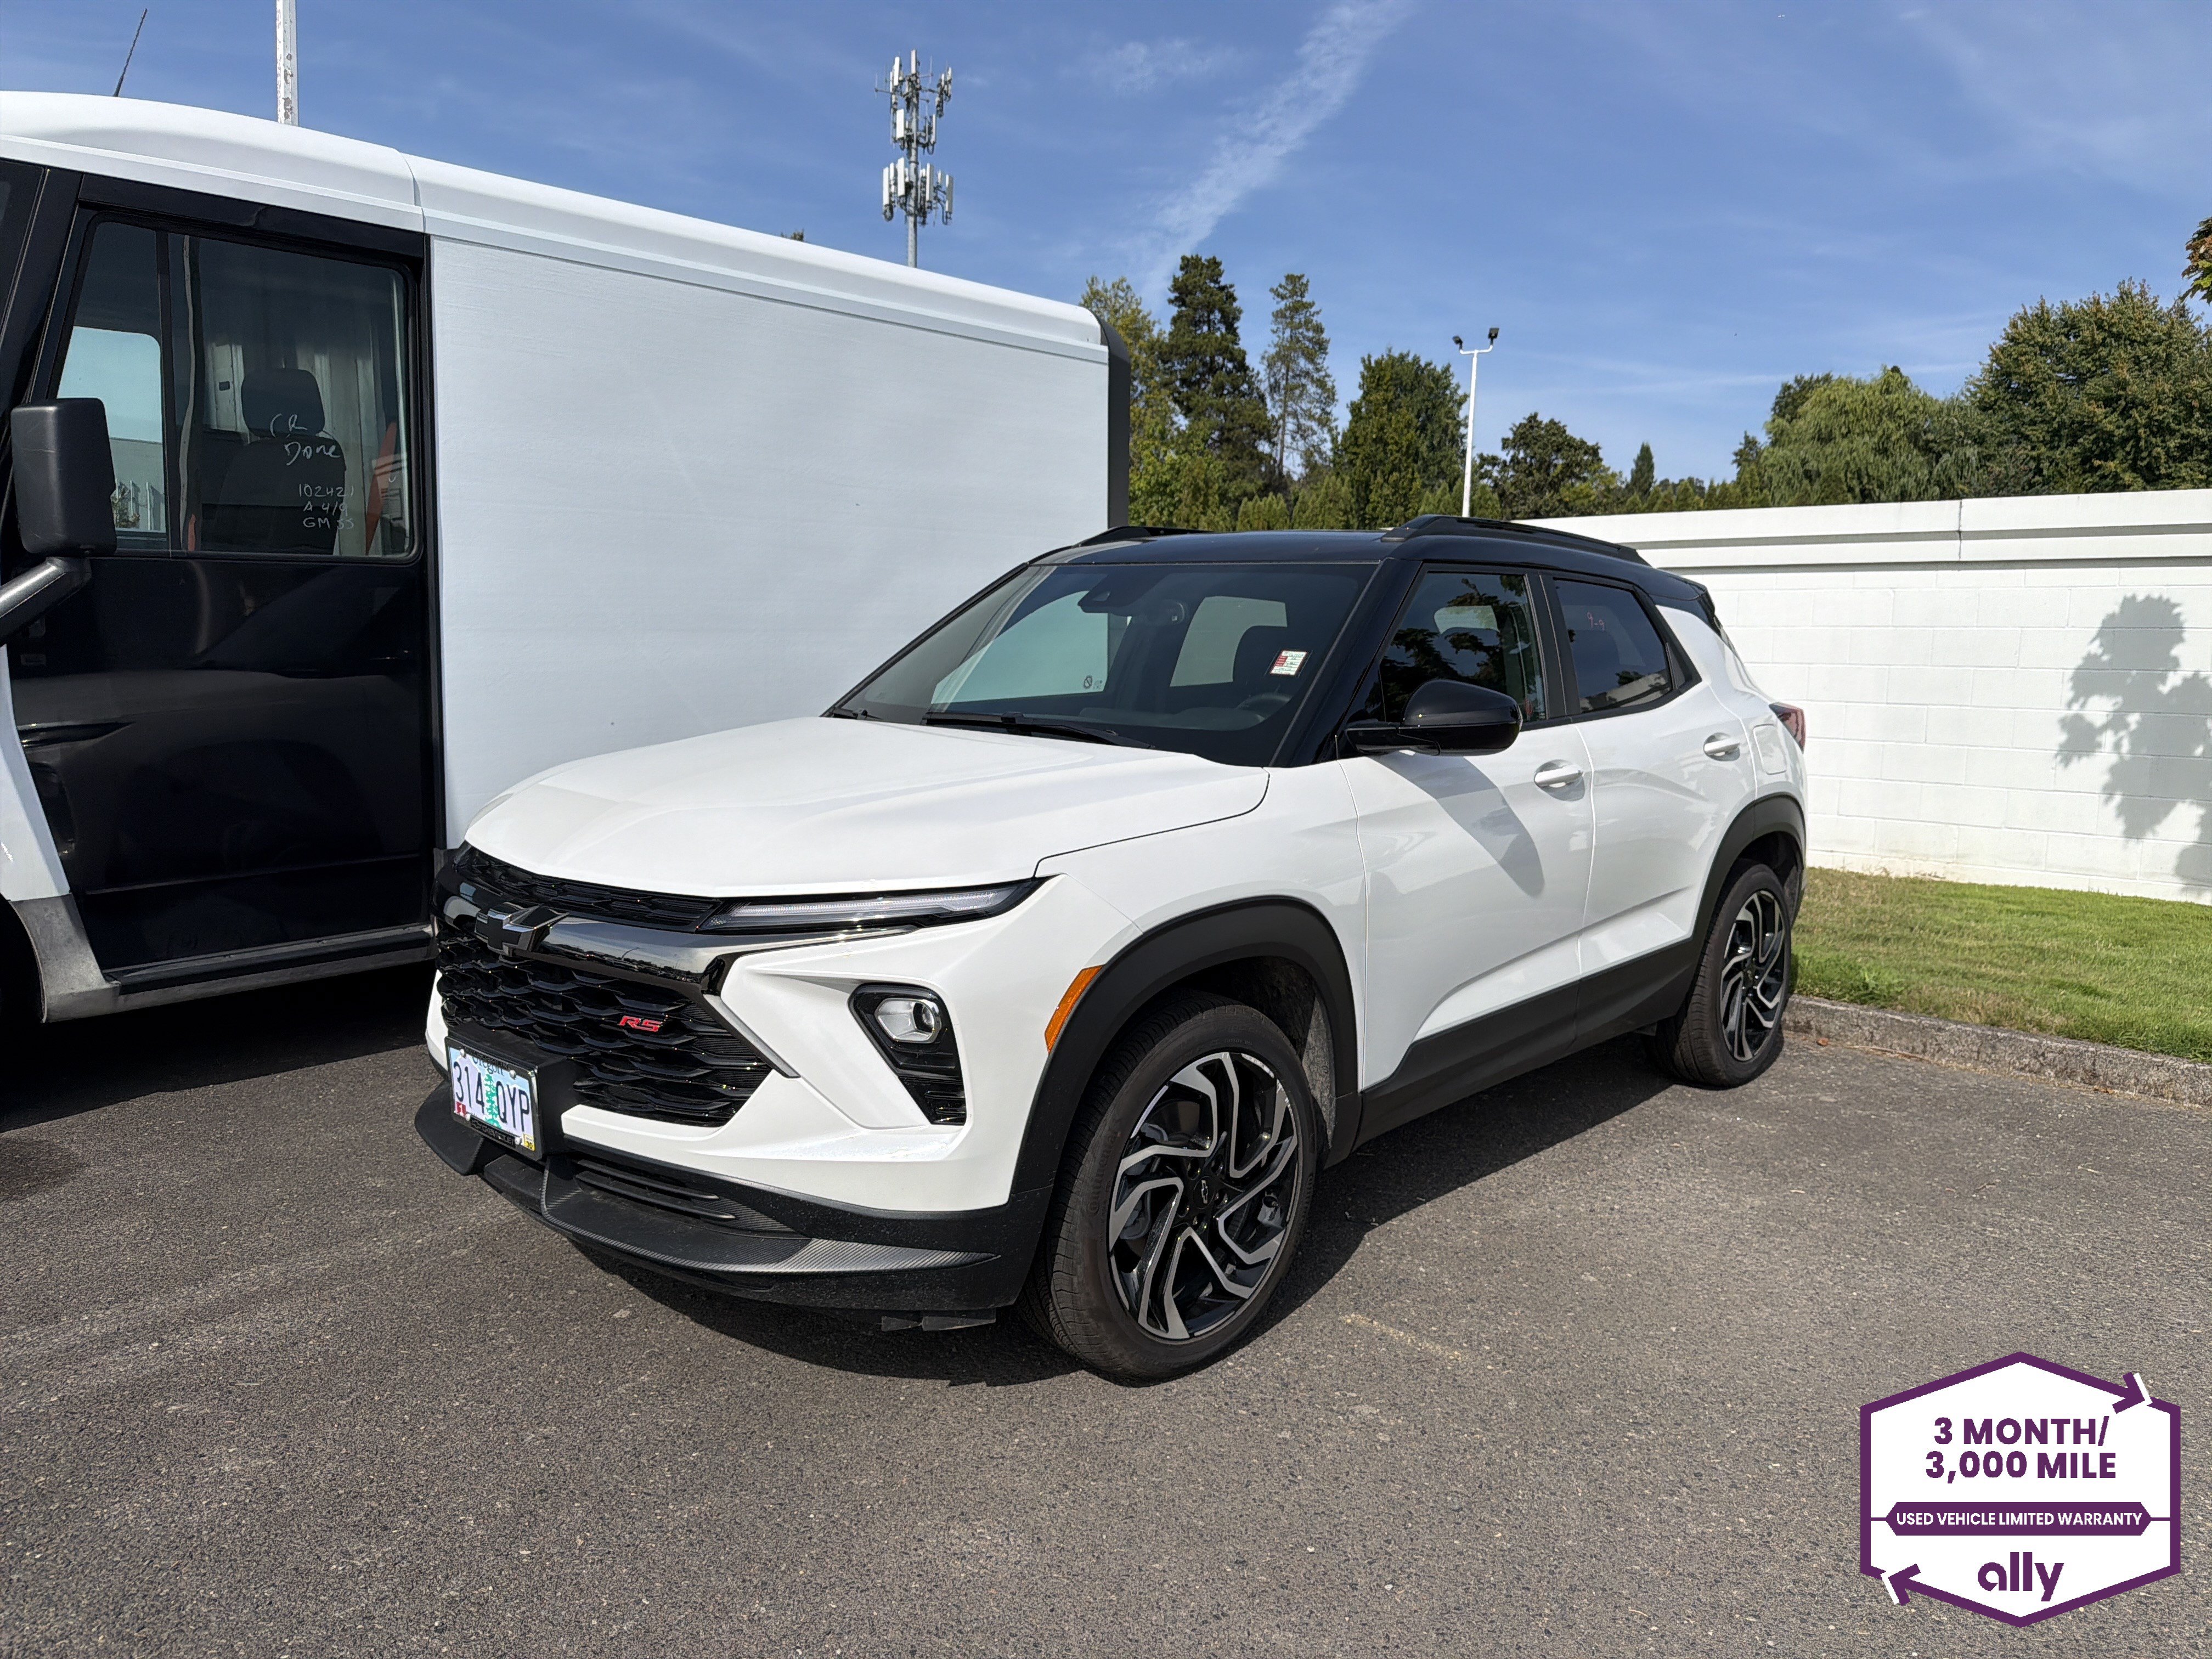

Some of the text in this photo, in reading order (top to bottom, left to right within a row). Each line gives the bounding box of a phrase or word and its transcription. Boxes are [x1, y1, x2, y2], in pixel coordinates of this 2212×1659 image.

[284, 441, 341, 466] Done
[617, 1015, 663, 1032] RS
[453, 1061, 530, 1132] 314 QYP
